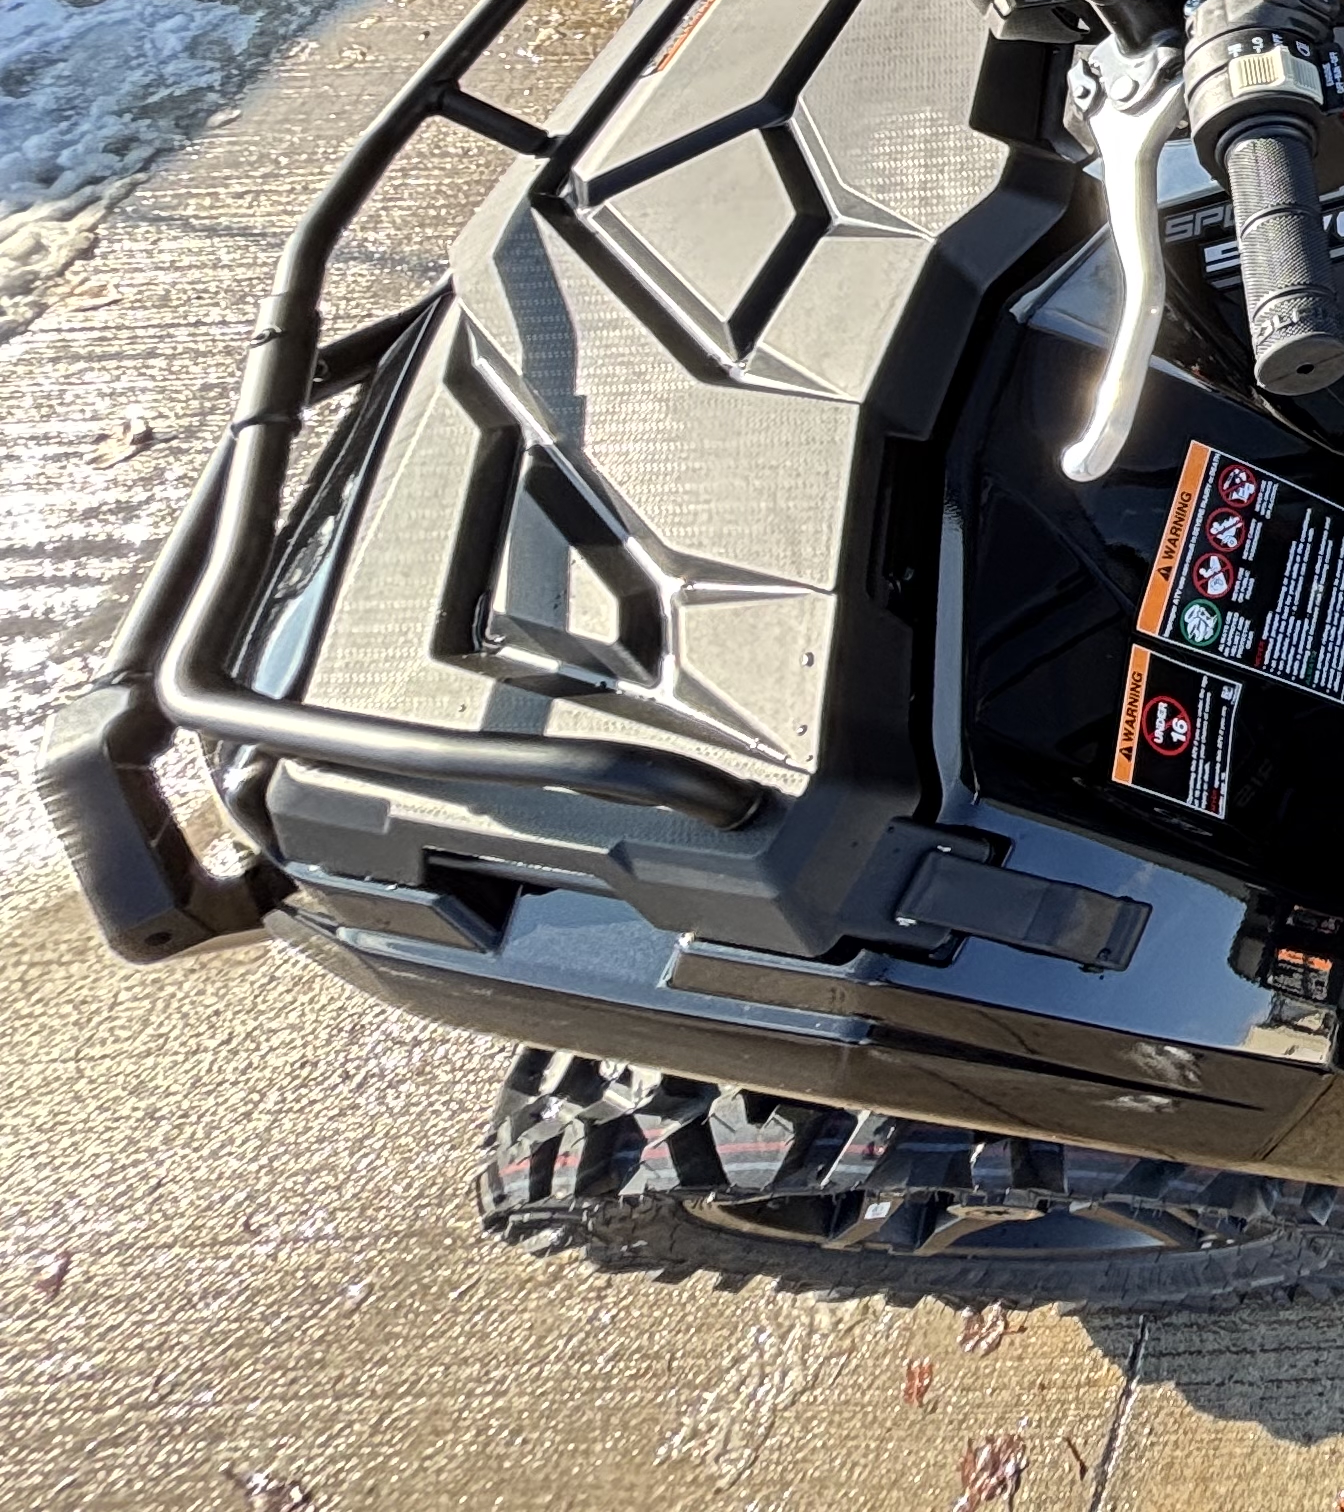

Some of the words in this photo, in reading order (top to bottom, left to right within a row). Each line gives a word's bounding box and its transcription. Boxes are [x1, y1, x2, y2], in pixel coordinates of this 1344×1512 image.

[1163, 491, 1191, 558] WARNING
[1123, 671, 1142, 741] WARNING
[1154, 702, 1167, 743] UNDER
[1171, 717, 1187, 744] 16
